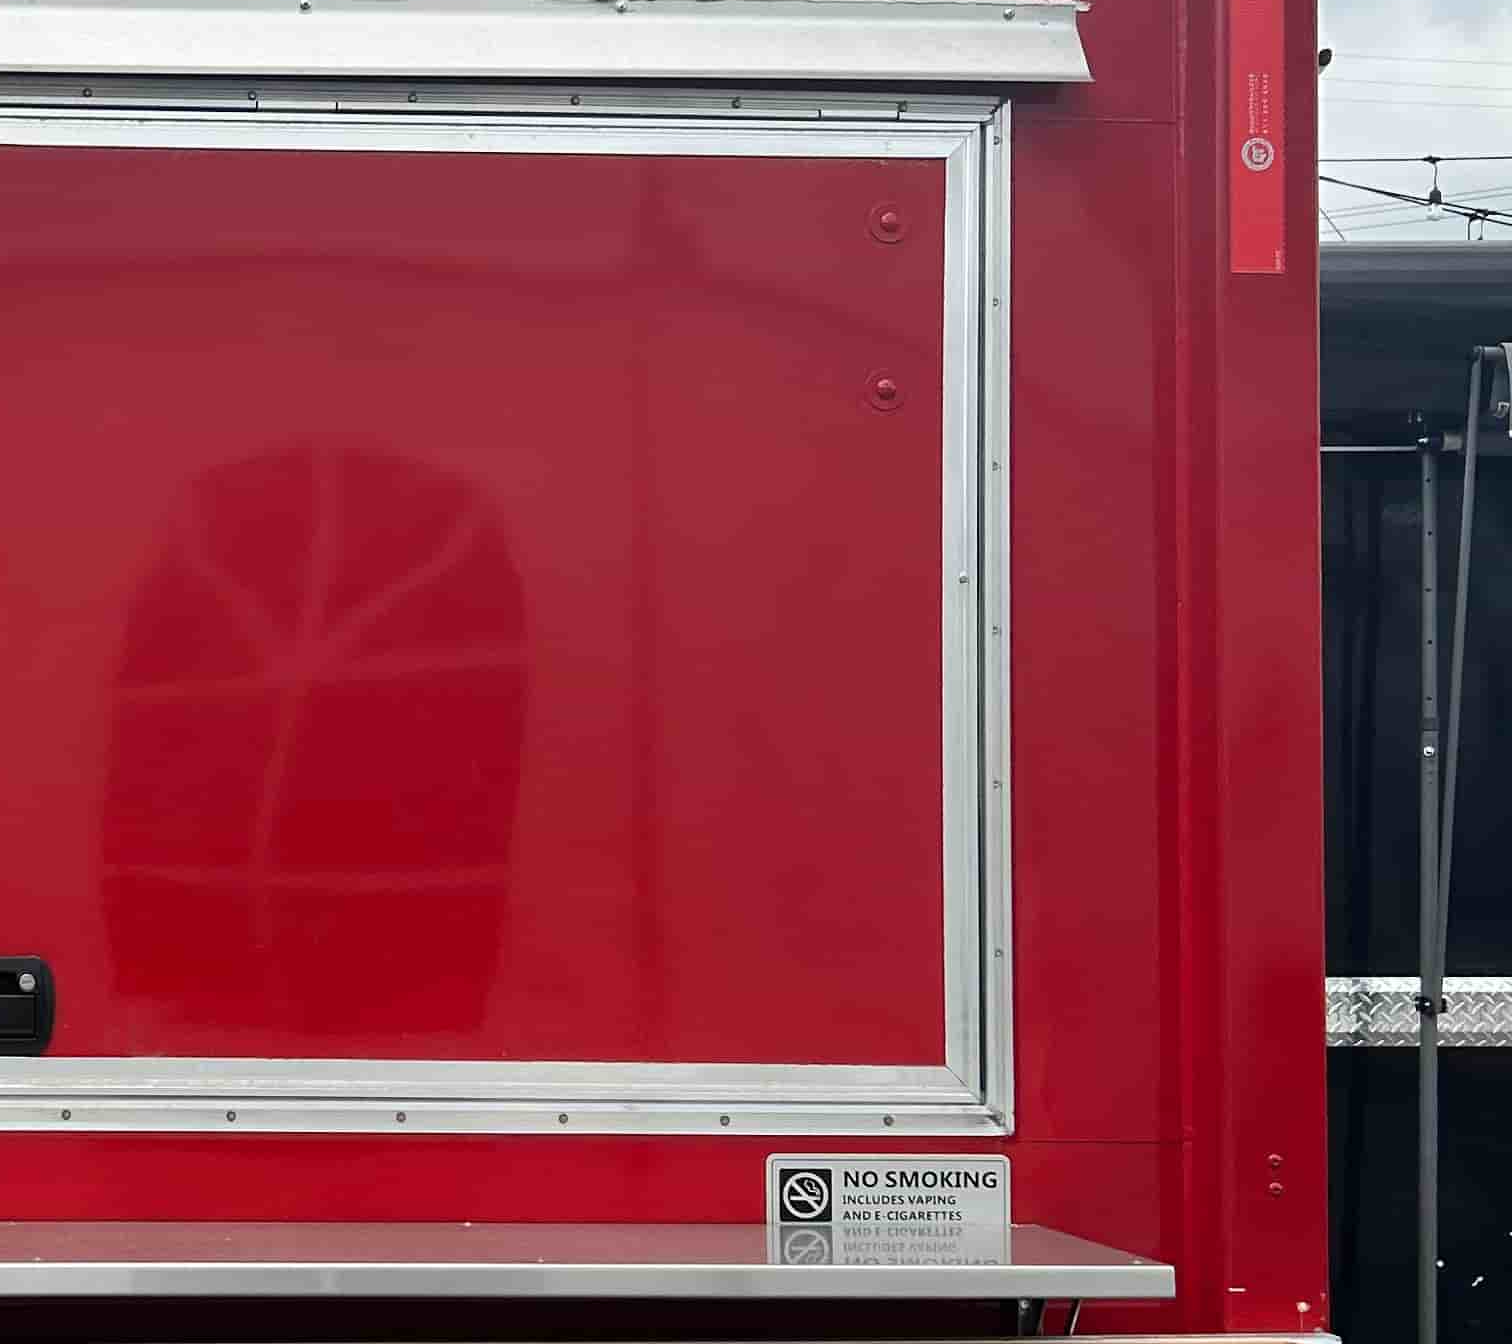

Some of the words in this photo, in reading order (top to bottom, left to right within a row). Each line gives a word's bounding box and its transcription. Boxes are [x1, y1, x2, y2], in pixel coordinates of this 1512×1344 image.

[844, 1171, 878, 1188] NO
[885, 1171, 998, 1188] SMOKING
[842, 1195, 904, 1205] INCLUDES
[908, 1196, 956, 1205] VAPING
[842, 1211, 871, 1221] AND
[875, 1211, 962, 1221] E-CIGARETTES
